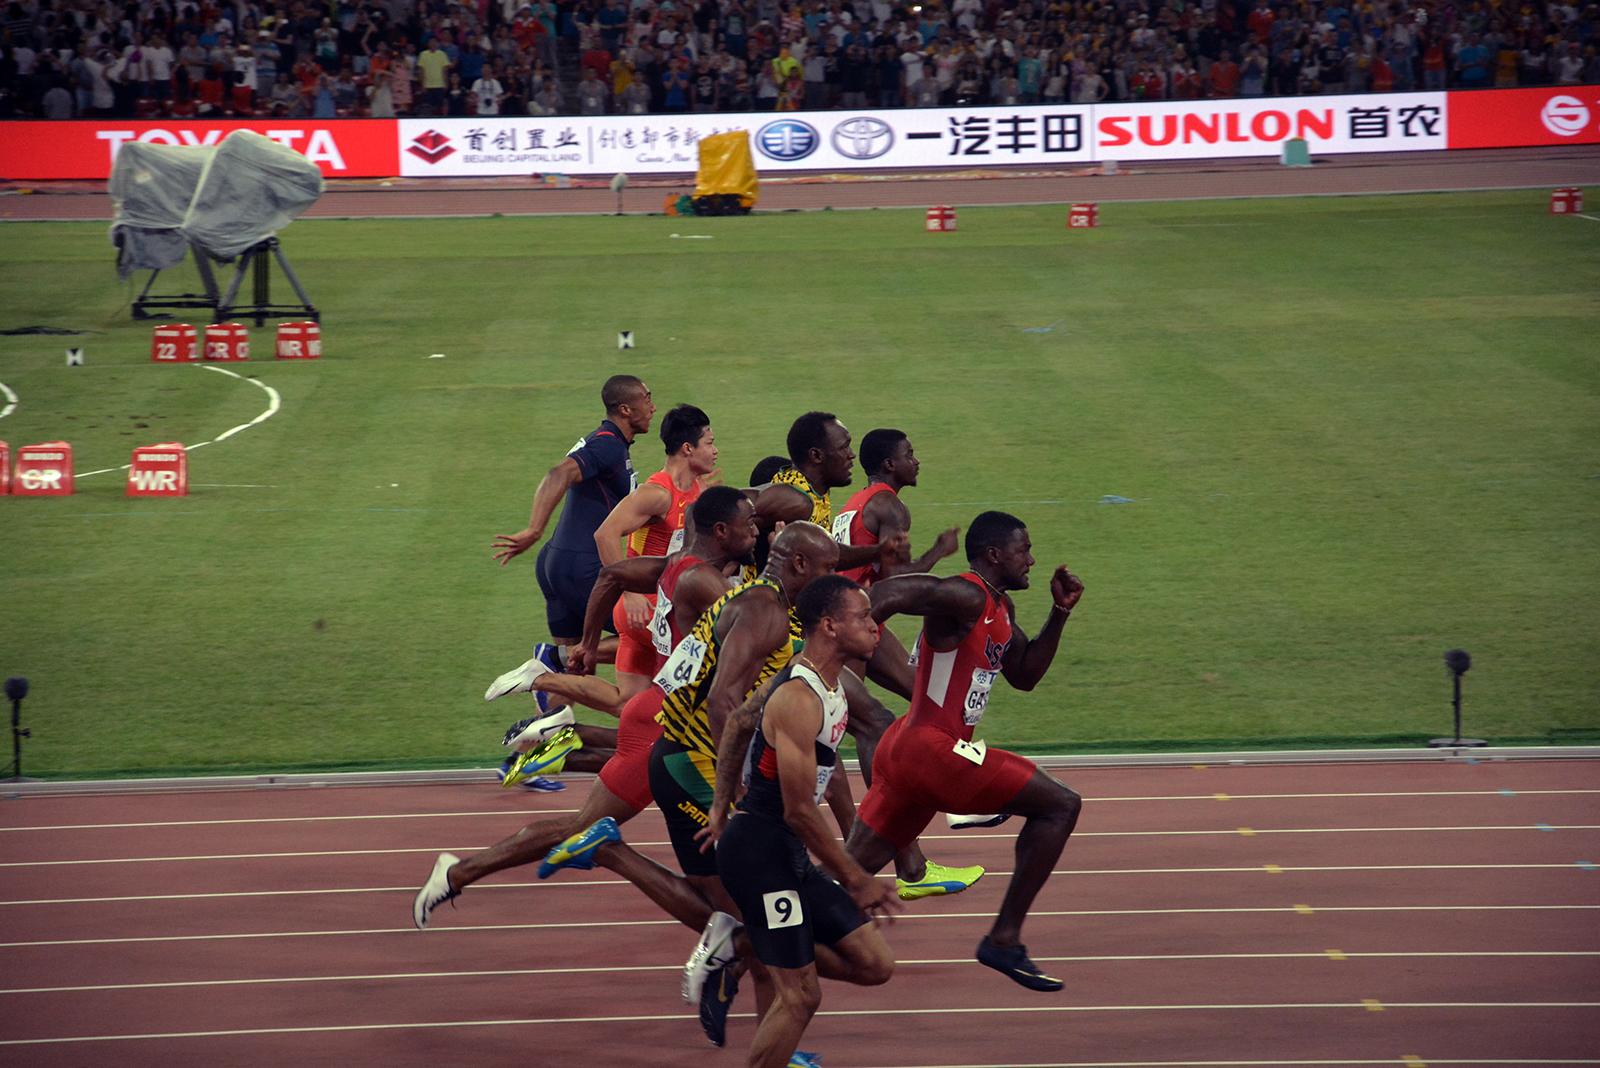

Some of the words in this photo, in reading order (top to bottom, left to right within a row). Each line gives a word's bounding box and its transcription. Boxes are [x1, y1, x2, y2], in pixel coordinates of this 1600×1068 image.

[906, 113, 1083, 156] 一汽丰田
[1098, 108, 1333, 147] SUNLON
[1348, 104, 1442, 138] 首农
[463, 127, 581, 152] 首创置业
[463, 154, 504, 164] BEIJING
[506, 154, 552, 163] CAPITAL
[552, 153, 582, 162] LAND
[22, 469, 61, 490] CR
[136, 470, 177, 491] WR
[774, 896, 793, 925] 9
